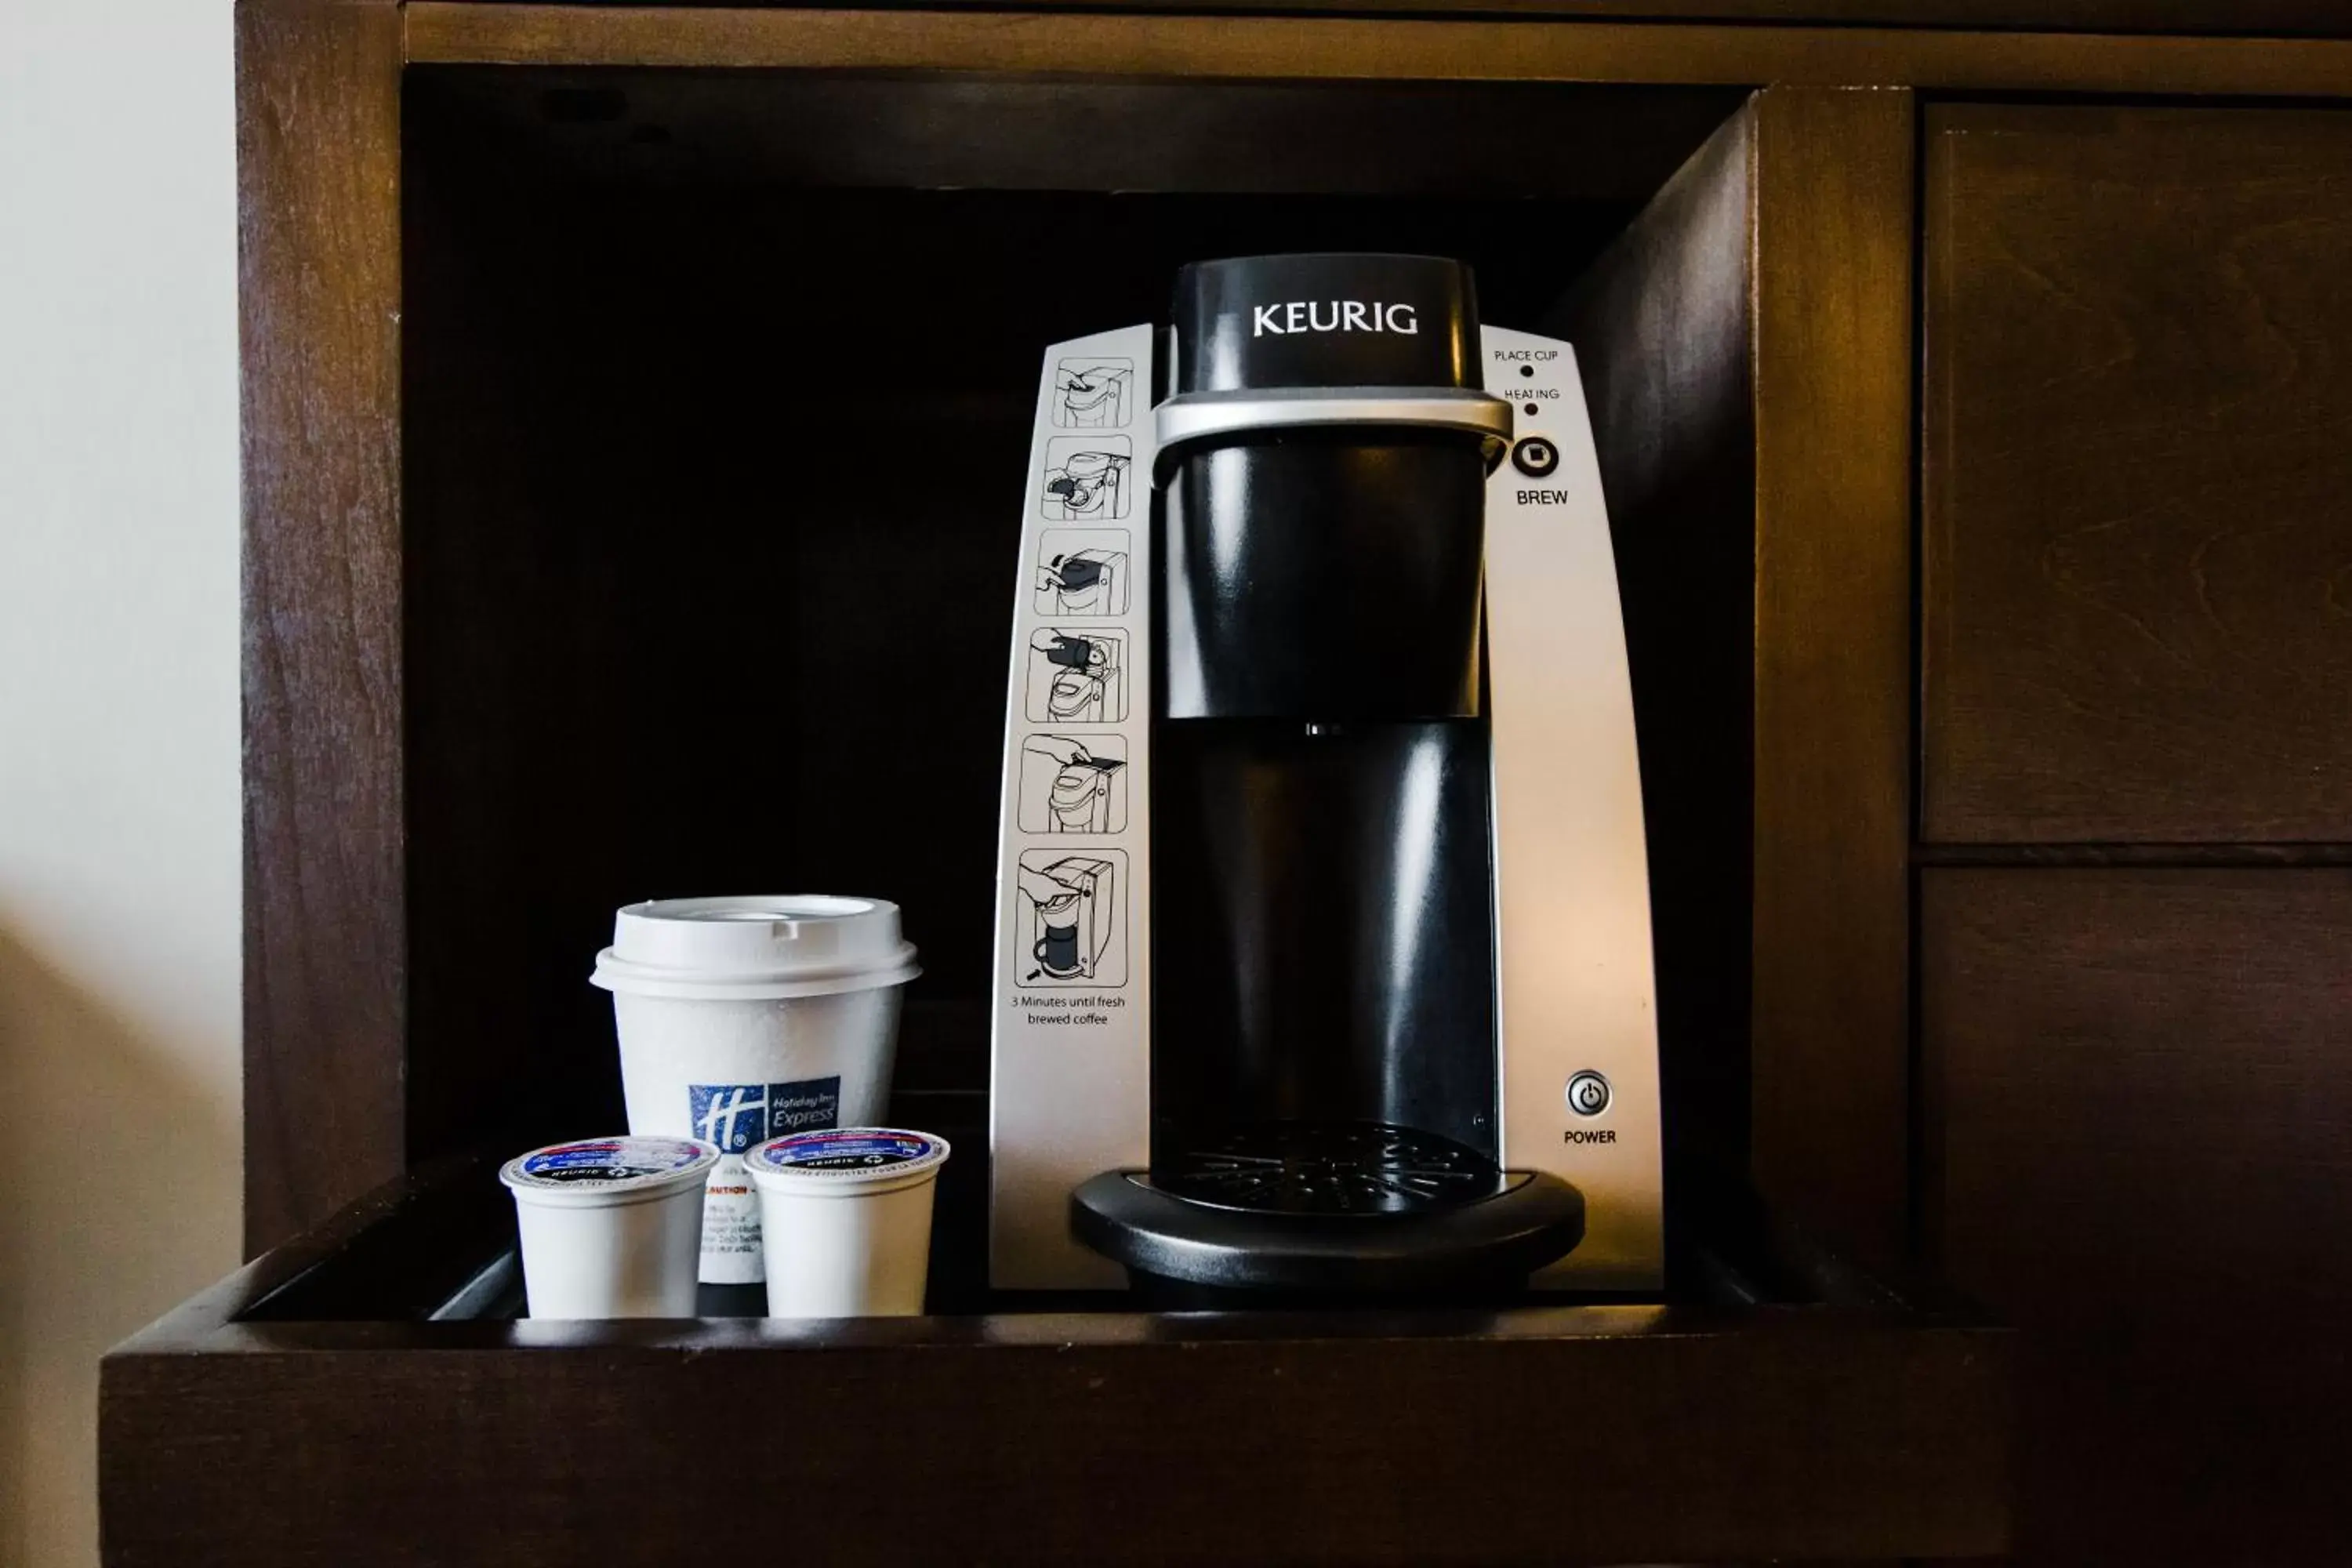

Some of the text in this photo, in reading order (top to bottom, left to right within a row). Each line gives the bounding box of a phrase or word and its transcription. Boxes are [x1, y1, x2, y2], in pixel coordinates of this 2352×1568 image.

[1254, 300, 1418, 337] KEURIG
[1494, 350, 1559, 361] PLACE CUP
[1504, 389, 1560, 399] HEATING
[1517, 490, 1568, 506] BREW
[1011, 996, 1125, 1007] 3 Minutes until fresh
[1028, 1012, 1109, 1025] brewed coffee
[773, 1093, 835, 1109] Holiday Inn
[773, 1108, 834, 1127] Express
[1564, 1131, 1617, 1144] POWER
